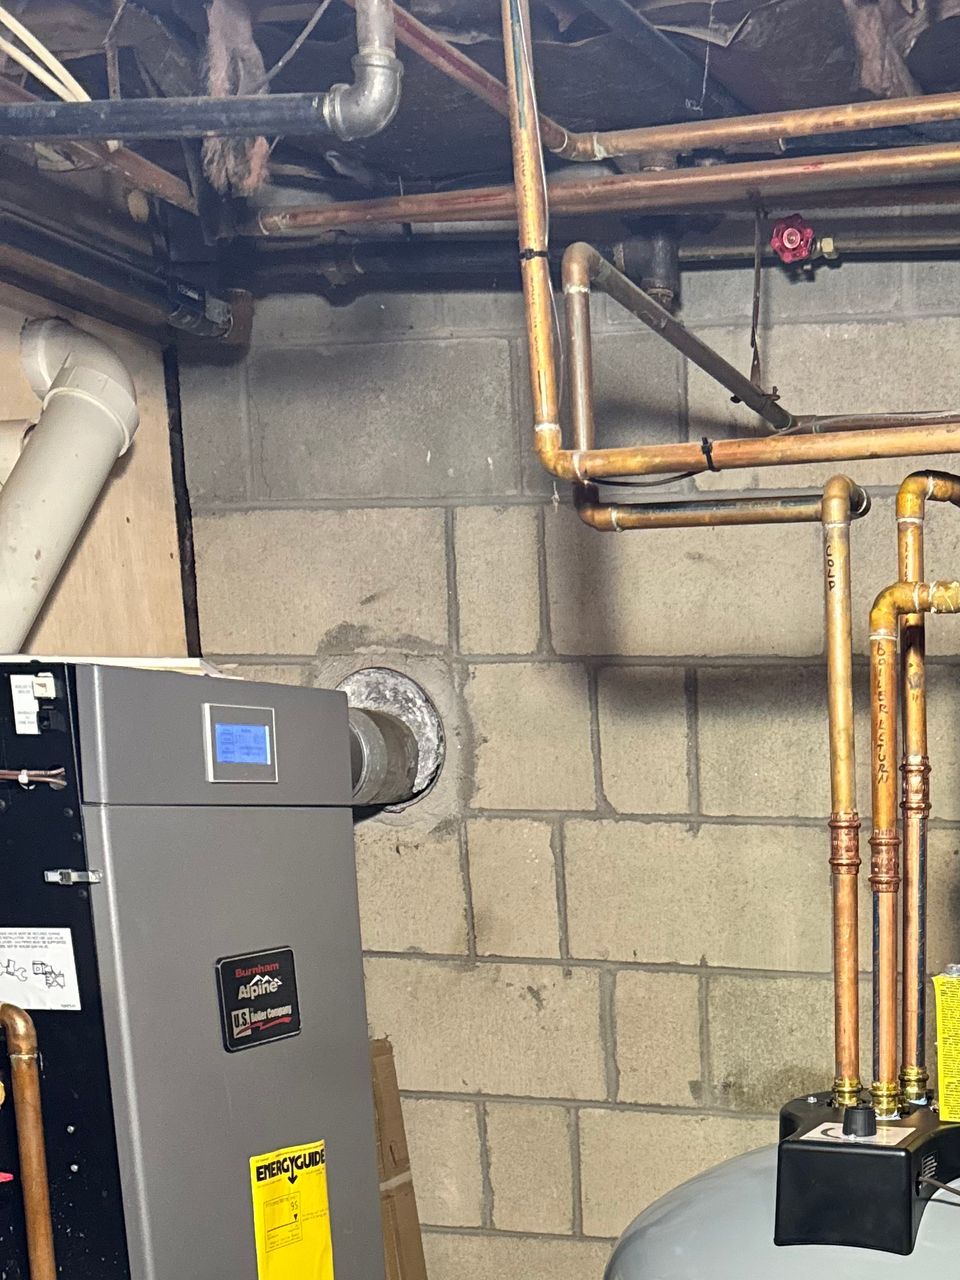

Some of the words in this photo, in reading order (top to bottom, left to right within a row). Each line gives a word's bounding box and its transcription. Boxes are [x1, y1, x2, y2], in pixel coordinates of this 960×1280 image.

[825, 544, 837, 592] COLD
[235, 962, 280, 978] Burnham
[238, 980, 279, 1000] Alpine
[233, 1011, 250, 1028] U.S.
[266, 1004, 292, 1019] Company
[256, 1149, 326, 1182] ENERGYGUIDE
